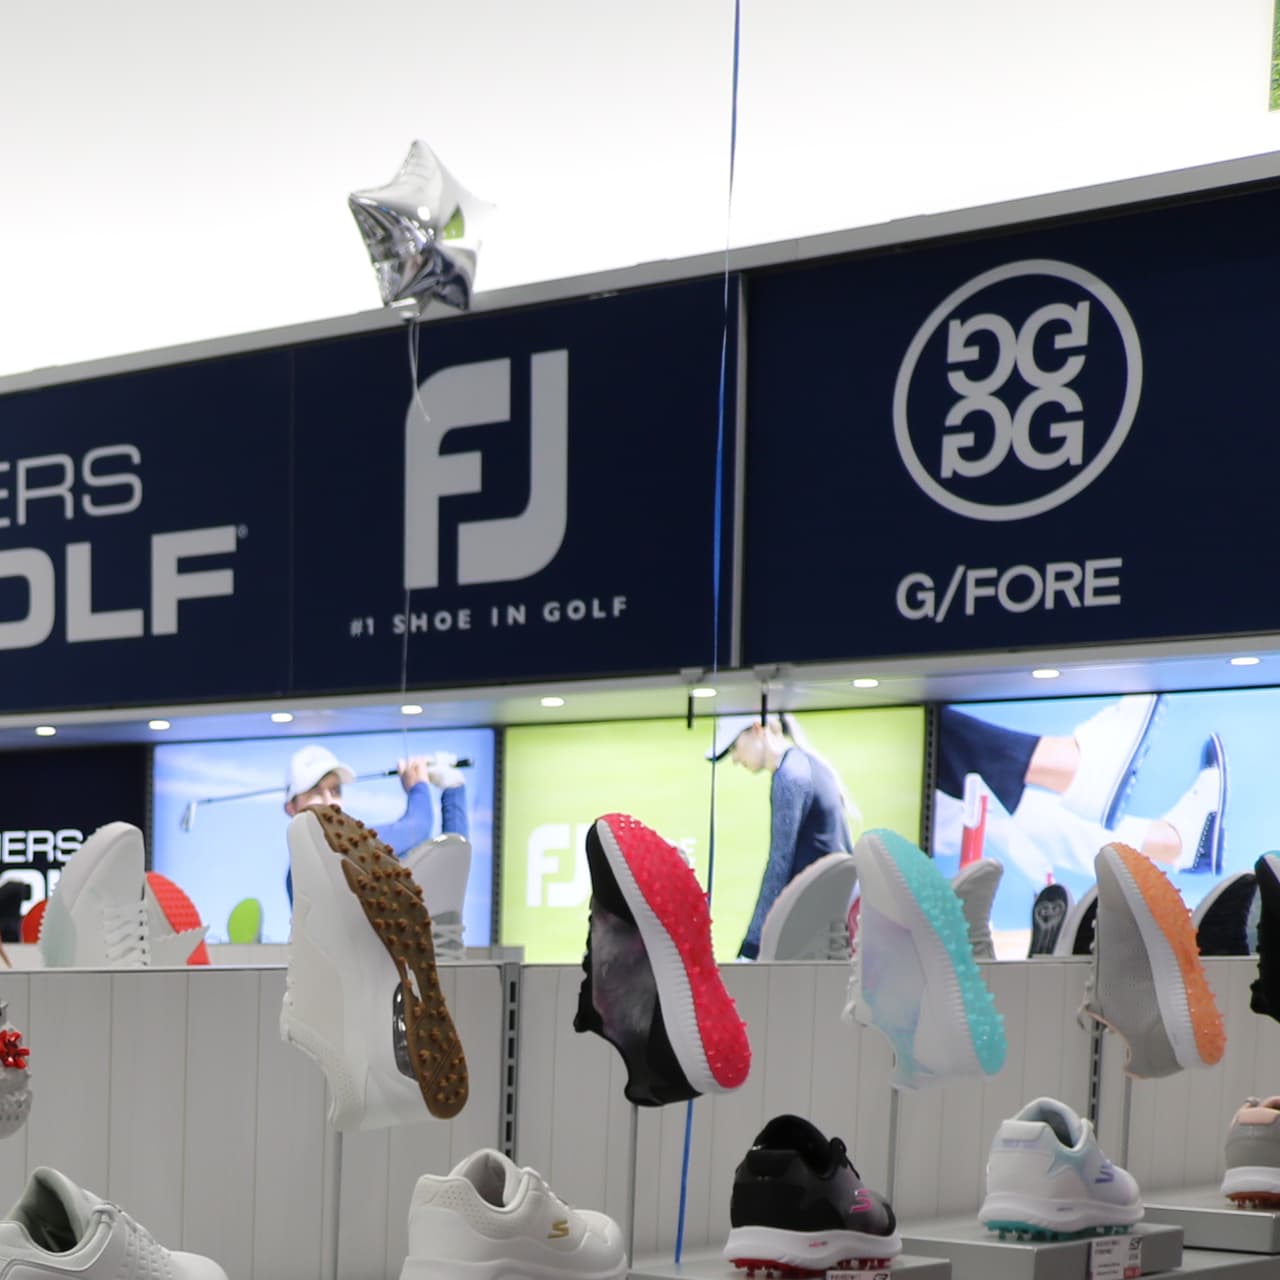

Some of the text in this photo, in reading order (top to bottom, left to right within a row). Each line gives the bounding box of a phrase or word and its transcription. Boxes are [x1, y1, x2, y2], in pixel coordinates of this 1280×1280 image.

[405, 349, 568, 589] FJ
[350, 597, 627, 636] #1 SHOE IN GOLF
[896, 558, 1122, 622] G/FORE
